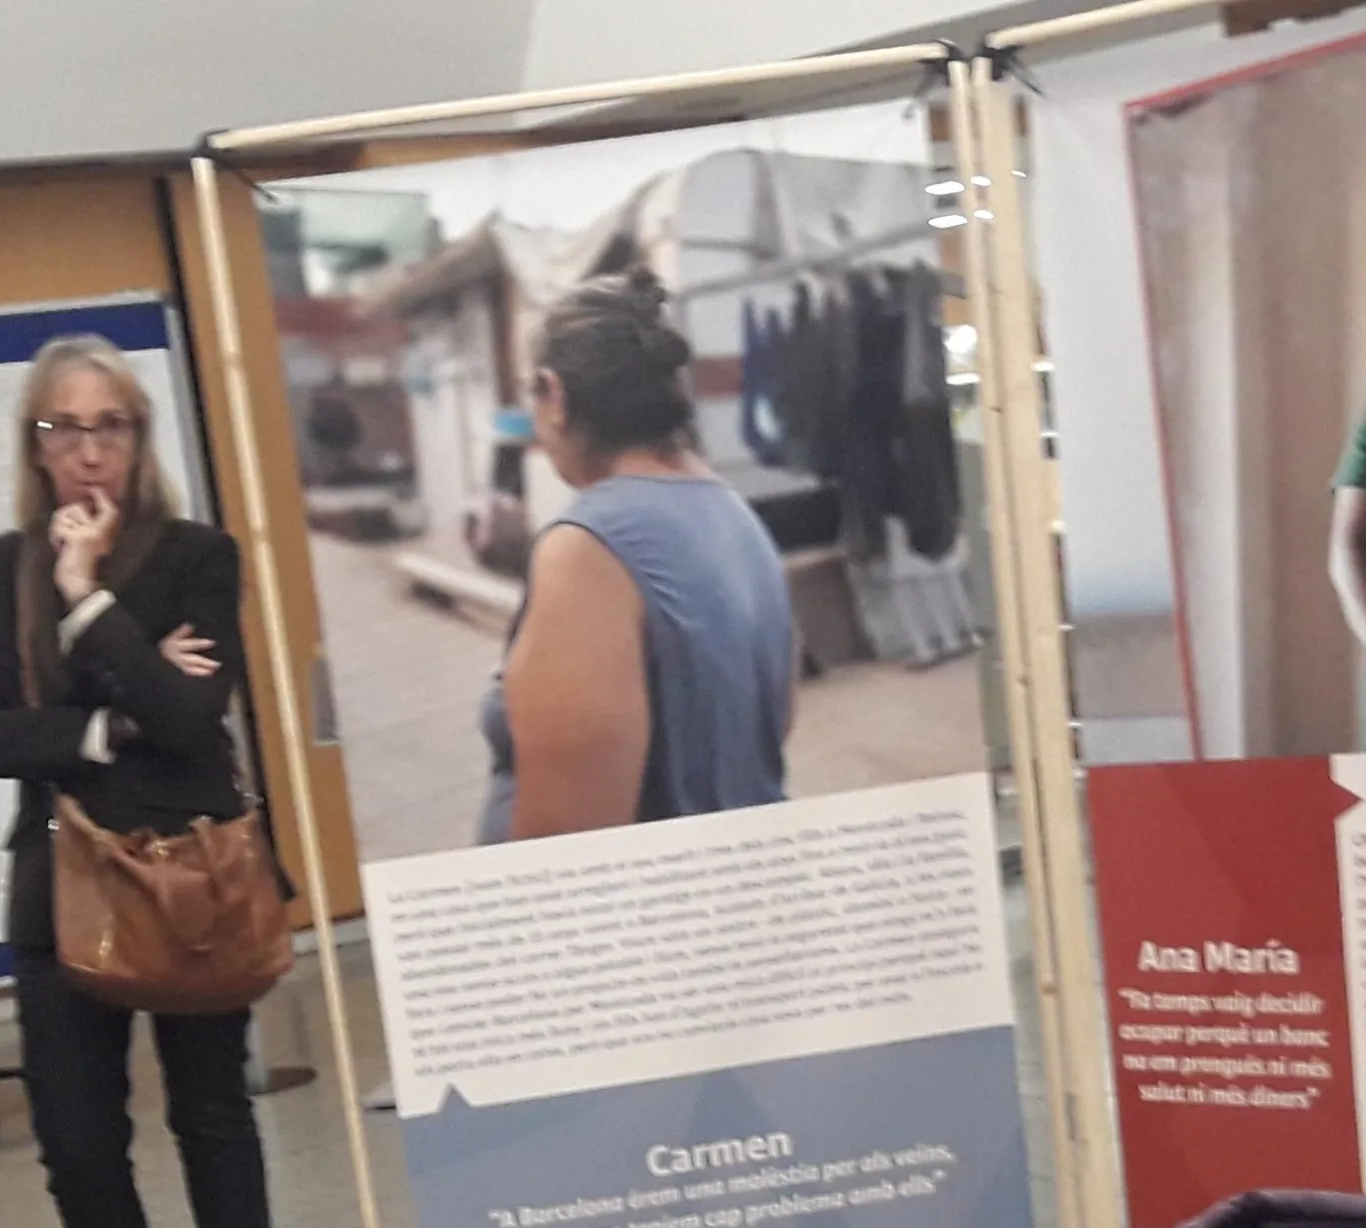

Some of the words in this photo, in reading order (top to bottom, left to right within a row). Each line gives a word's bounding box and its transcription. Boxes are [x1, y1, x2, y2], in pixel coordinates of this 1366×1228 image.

[1138, 941, 1200, 973] Ana
[1203, 938, 1300, 974] María
[1251, 1028, 1277, 1045] un
[1123, 1054, 1147, 1070] no
[1267, 1056, 1286, 1075] ni
[1187, 1082, 1205, 1102] ni
[646, 1131, 793, 1176] Carmen
[518, 1197, 624, 1227] Barcelona
[683, 1180, 725, 1199] una
[822, 1161, 857, 1183] per
[704, 1208, 743, 1228] cap
[745, 1192, 845, 1226] problema
[847, 1179, 896, 1206] amb
